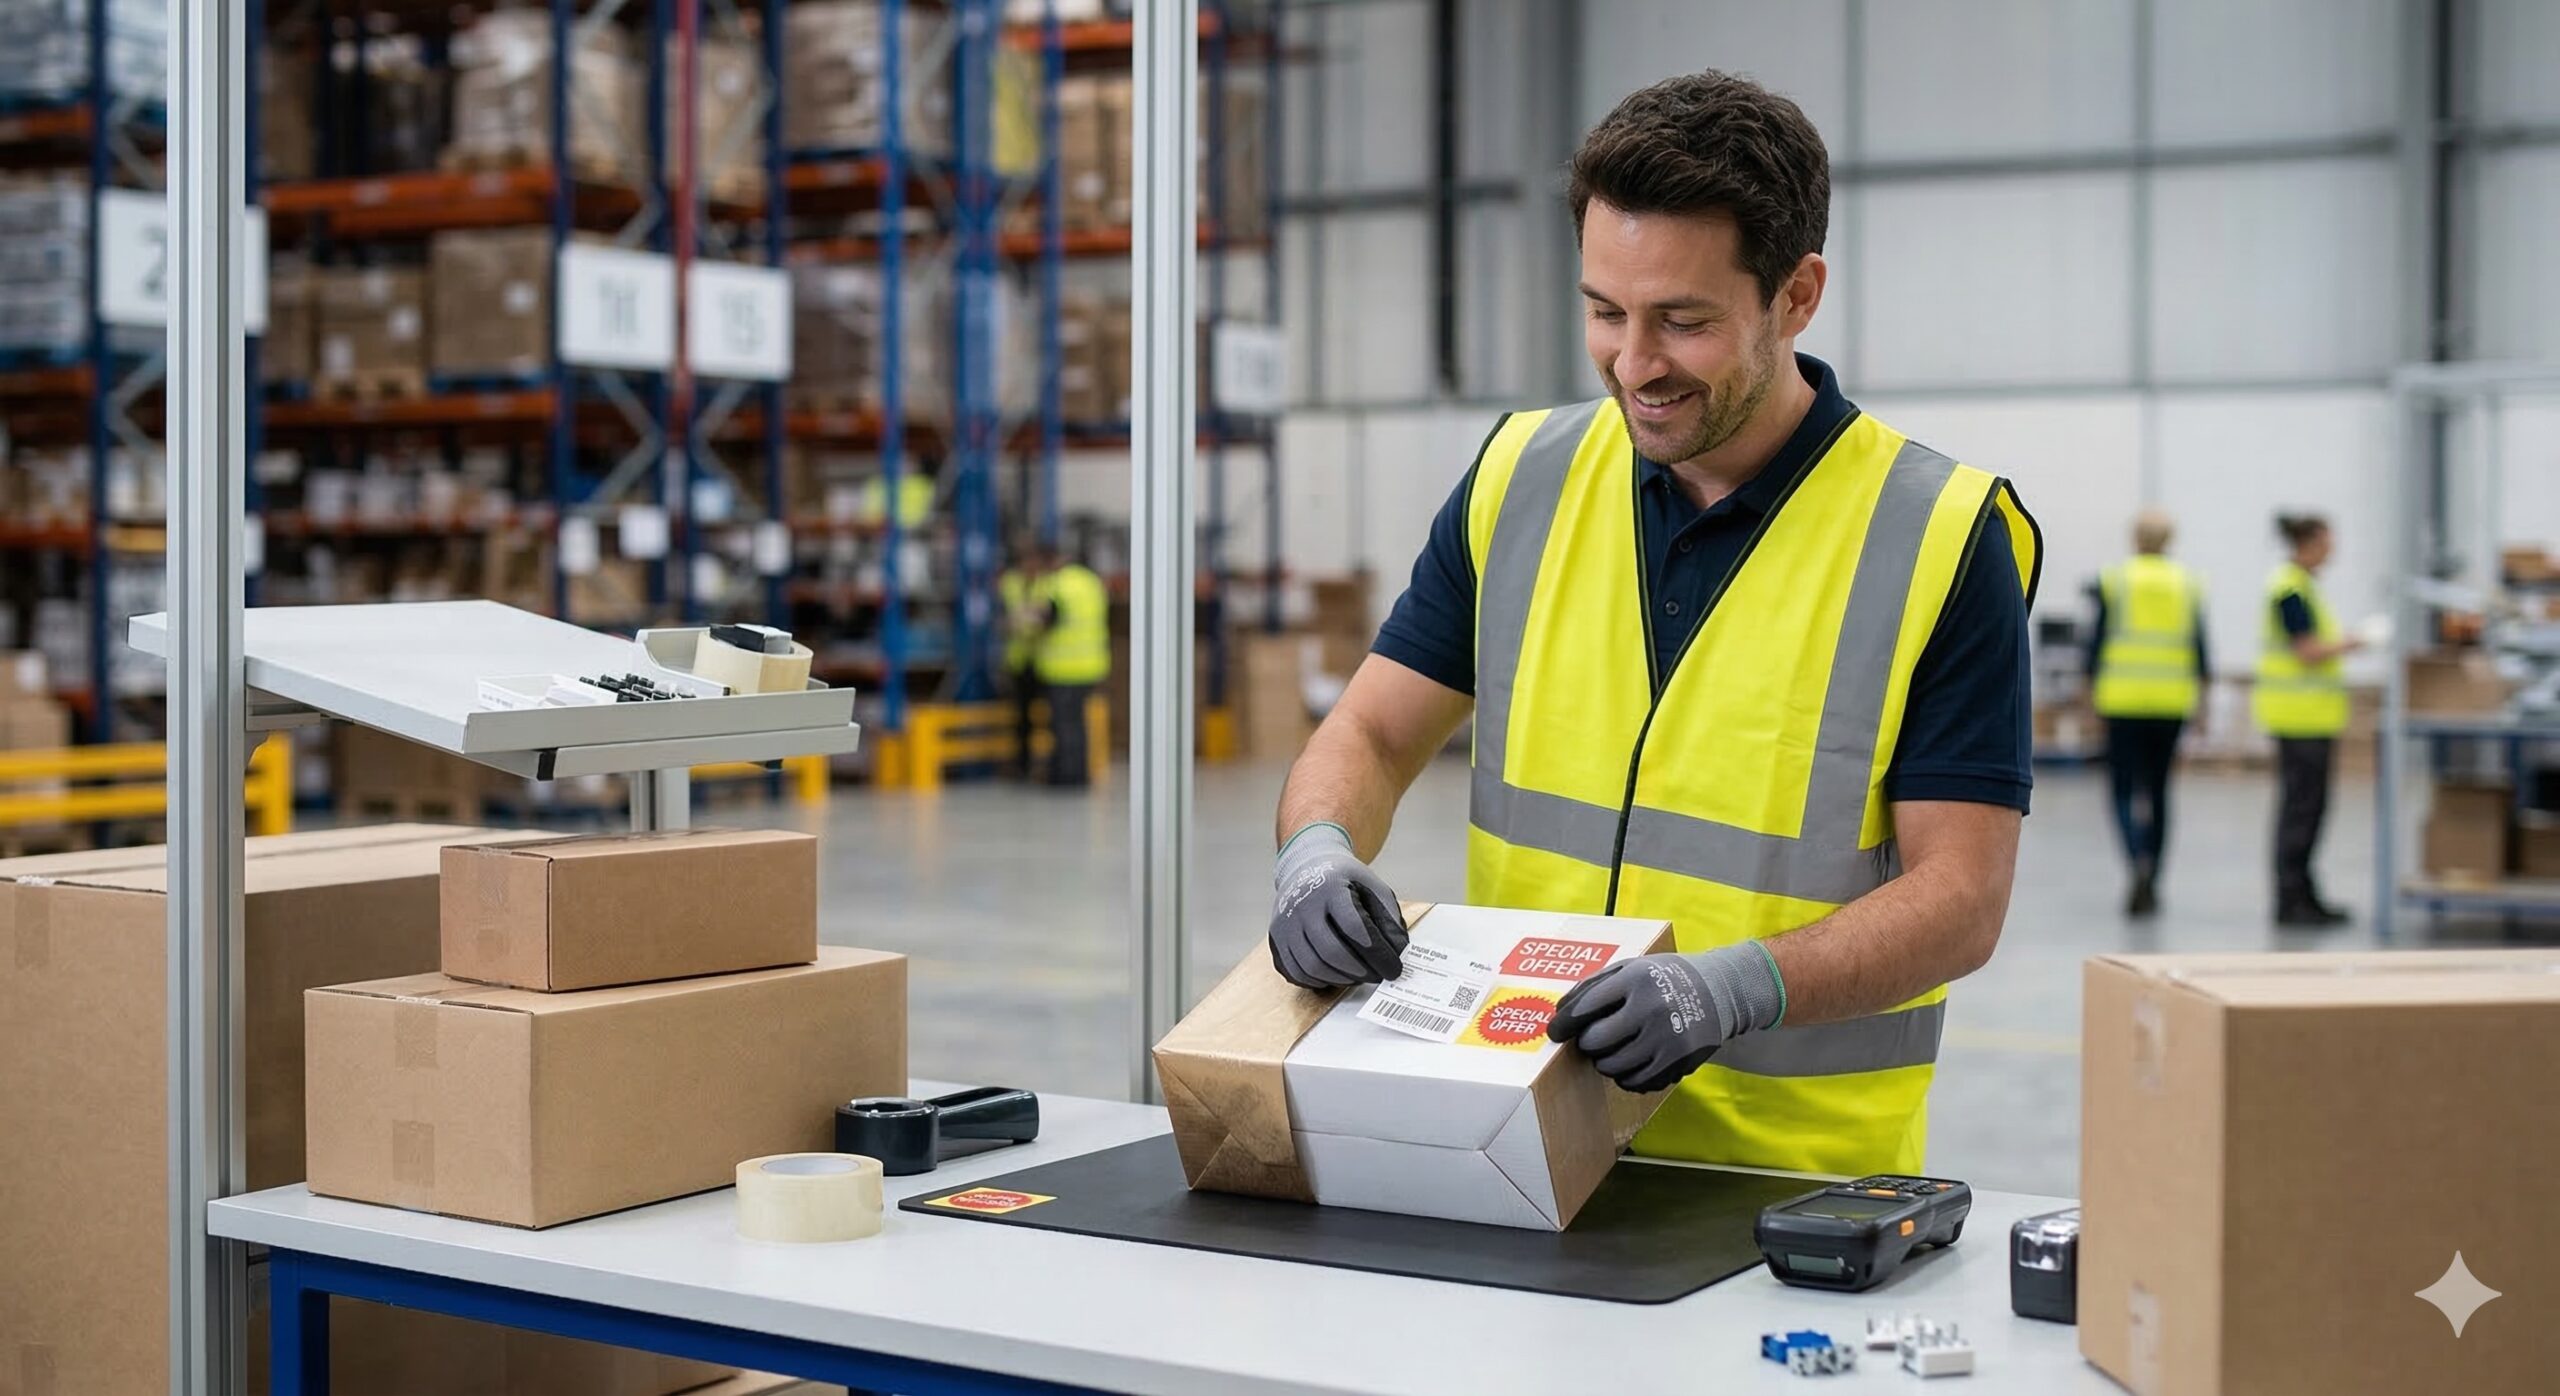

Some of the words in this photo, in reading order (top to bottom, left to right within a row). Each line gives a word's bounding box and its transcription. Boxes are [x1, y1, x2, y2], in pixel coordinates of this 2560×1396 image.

[1520, 942, 1602, 962] SPECIAL
[1519, 958, 1584, 976] OFFER
[1491, 1006, 1553, 1024] SPECIAL
[1490, 1019, 1536, 1034] OFFER
